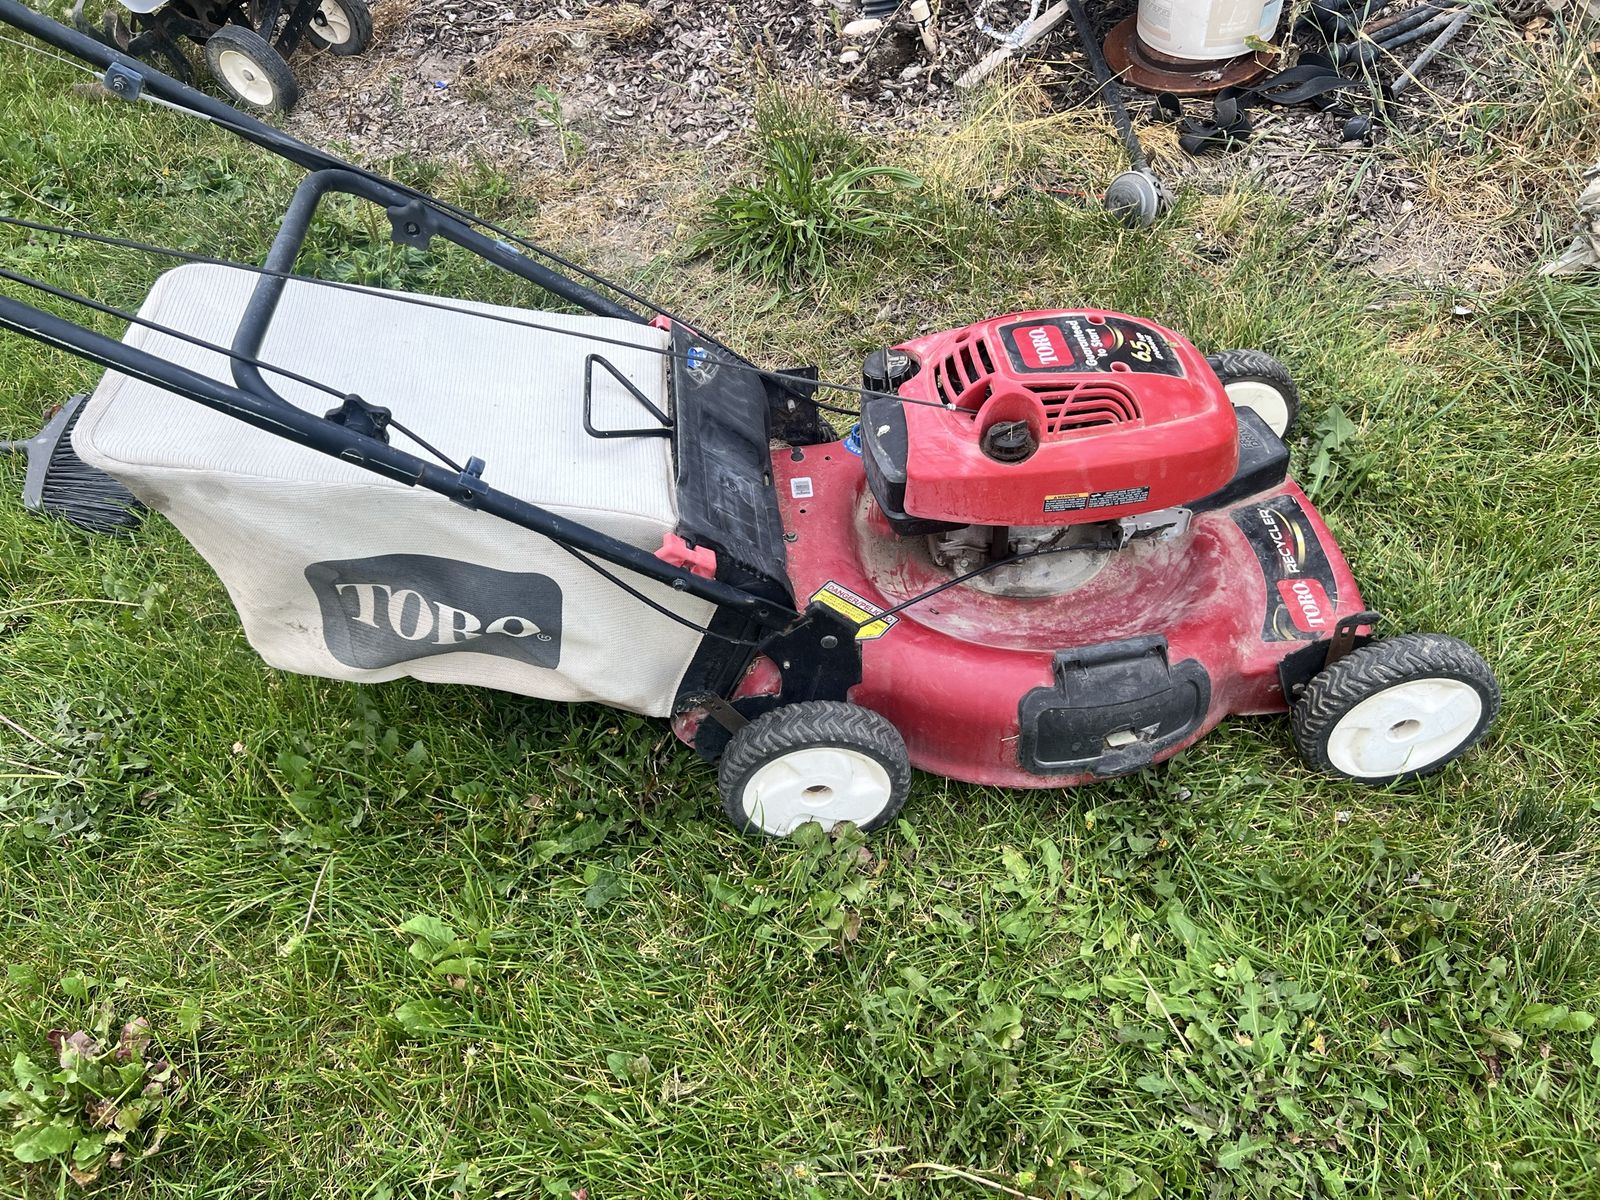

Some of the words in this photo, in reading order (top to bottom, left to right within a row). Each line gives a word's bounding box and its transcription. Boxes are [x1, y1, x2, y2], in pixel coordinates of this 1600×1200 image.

[1028, 328, 1059, 365] TORO
[1065, 320, 1098, 367] Guaranteed
[1085, 328, 1104, 347] Start
[1097, 348, 1108, 357] to
[1259, 508, 1300, 574] RECYCLER
[335, 583, 542, 645] TORO
[1292, 582, 1326, 628] TORO
